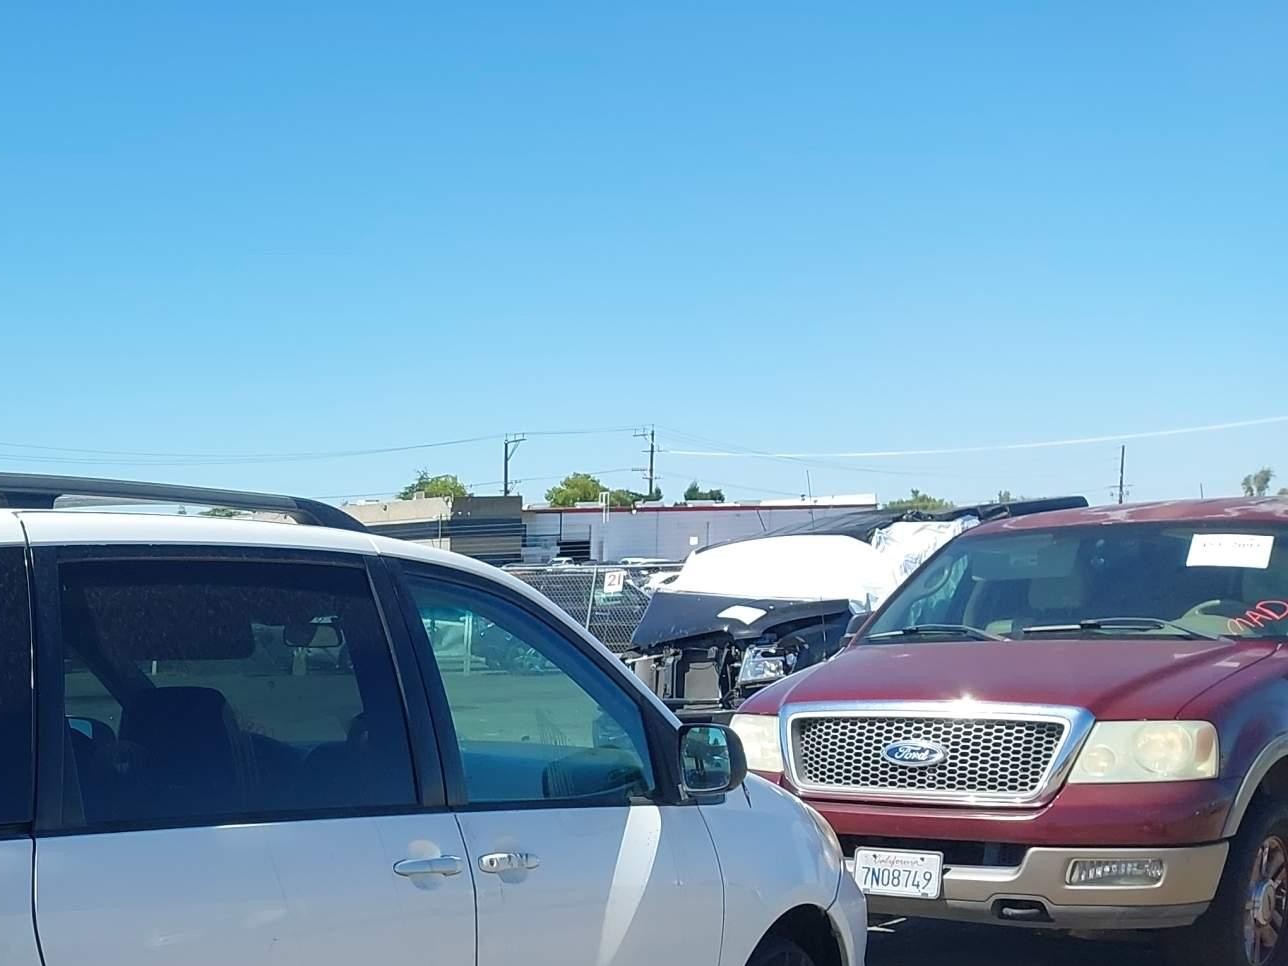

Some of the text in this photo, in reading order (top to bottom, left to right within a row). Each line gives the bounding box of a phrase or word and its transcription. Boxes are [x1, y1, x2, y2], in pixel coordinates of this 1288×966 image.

[607, 573, 622, 587] 21
[894, 746, 930, 761] Ford
[862, 866, 933, 890] 7N08749
